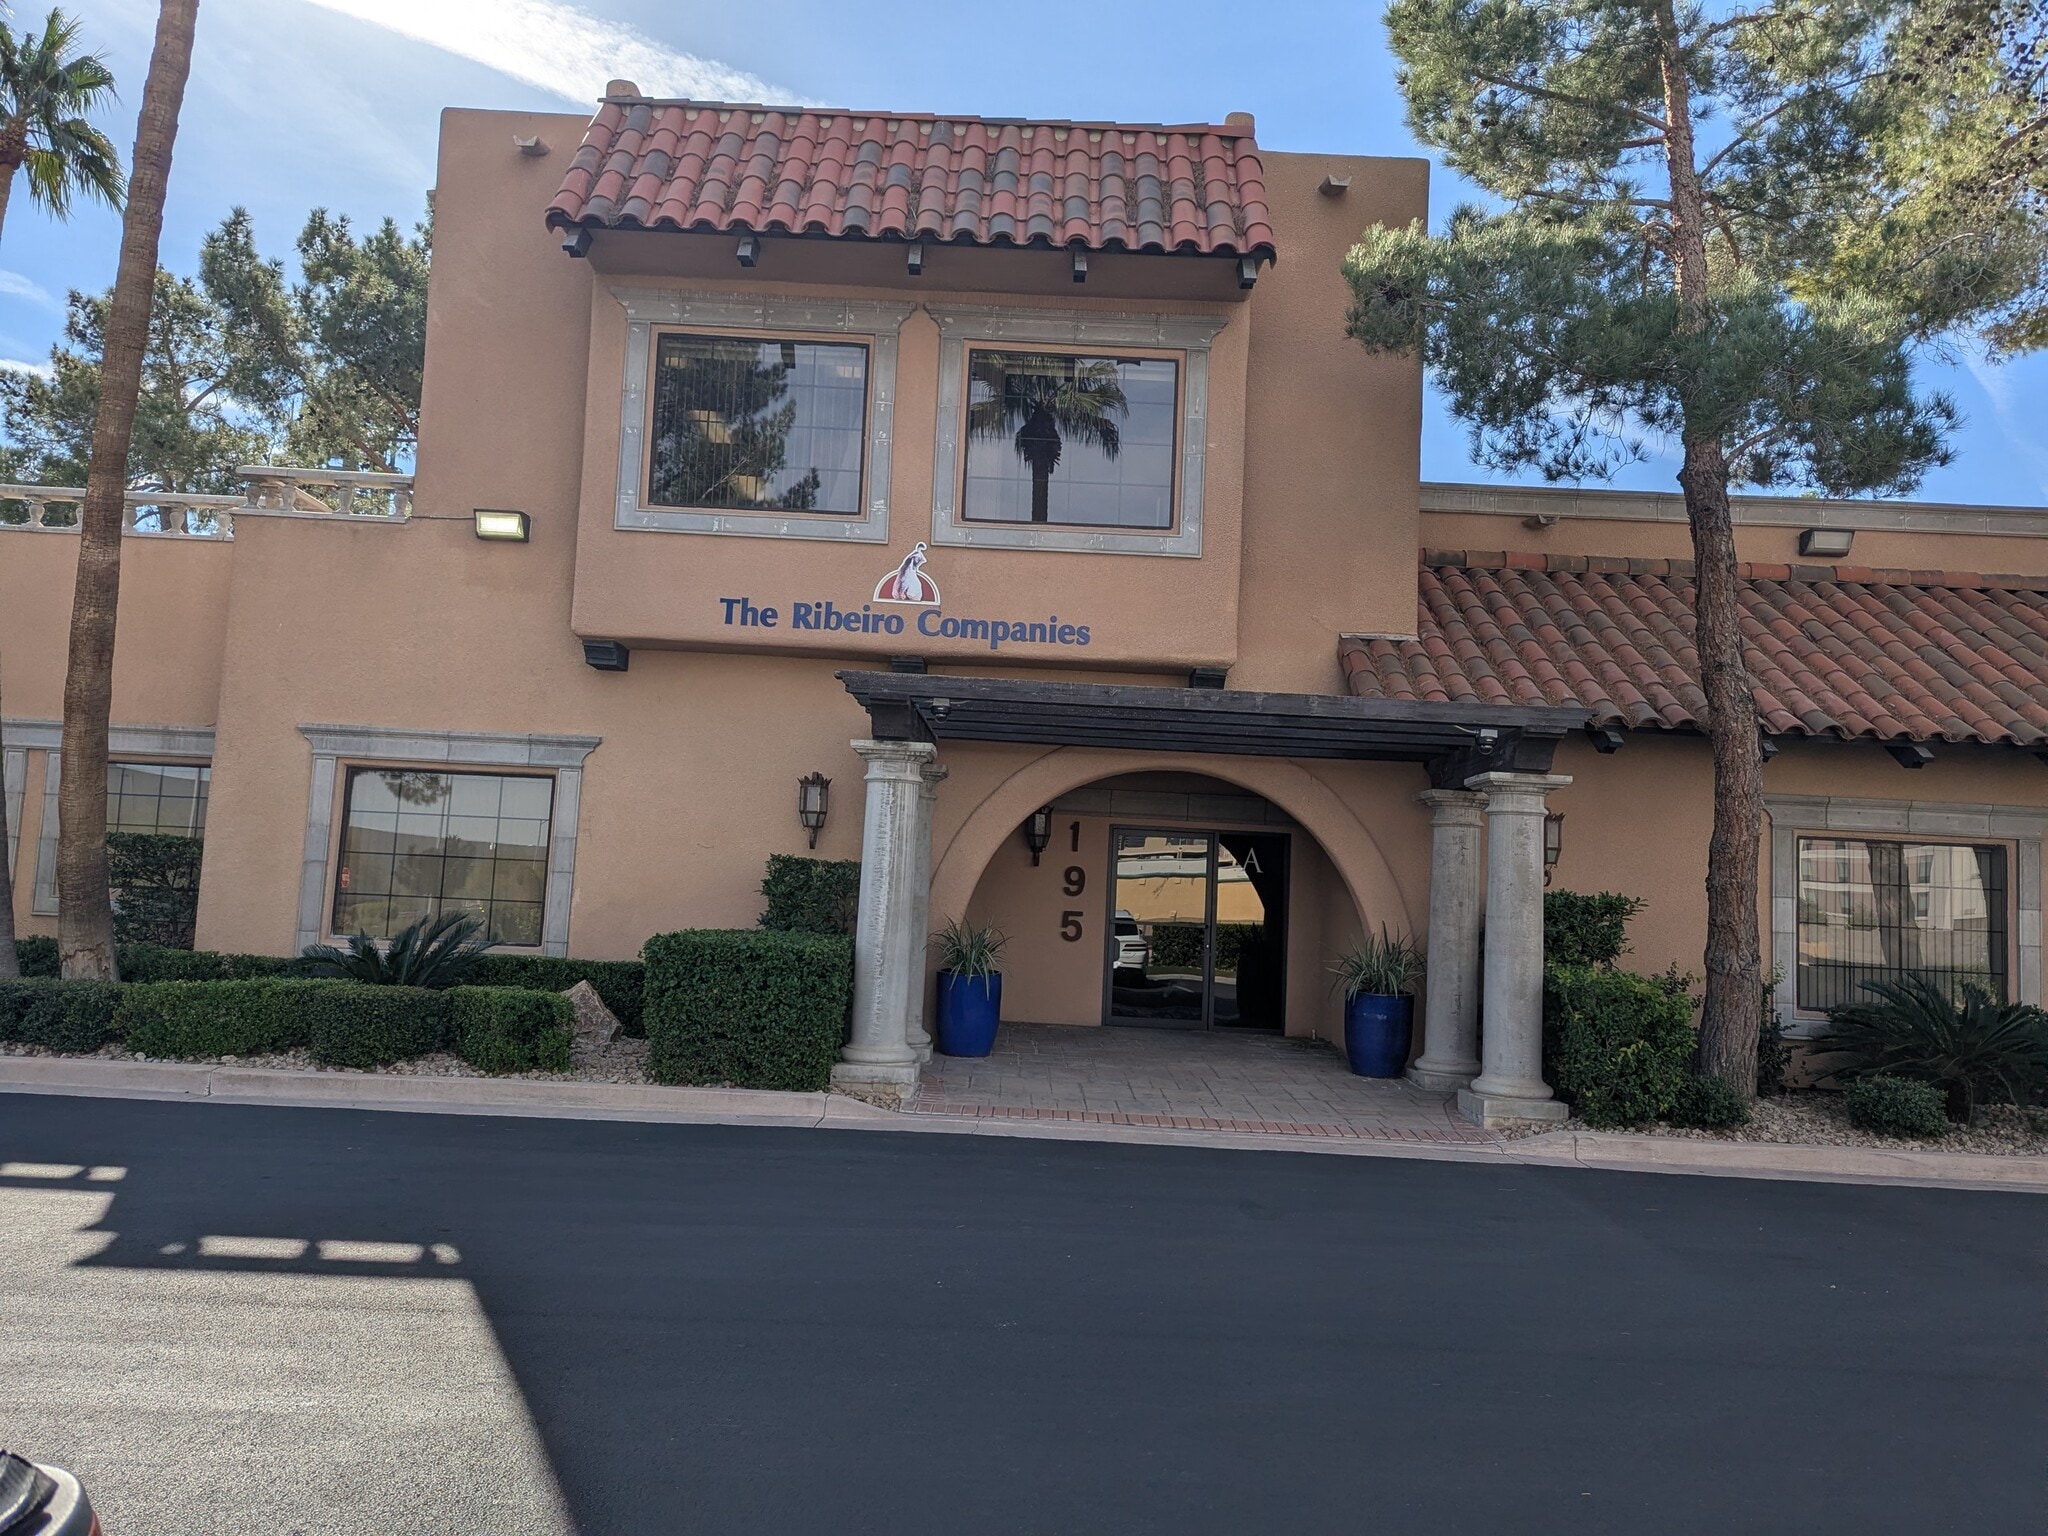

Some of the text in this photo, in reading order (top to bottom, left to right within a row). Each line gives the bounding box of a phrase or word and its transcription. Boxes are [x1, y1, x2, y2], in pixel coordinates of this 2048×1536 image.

[719, 597, 1091, 649] The Ribeiro Companies
[1061, 821, 1086, 942] 195
[1242, 847, 1264, 874] A
